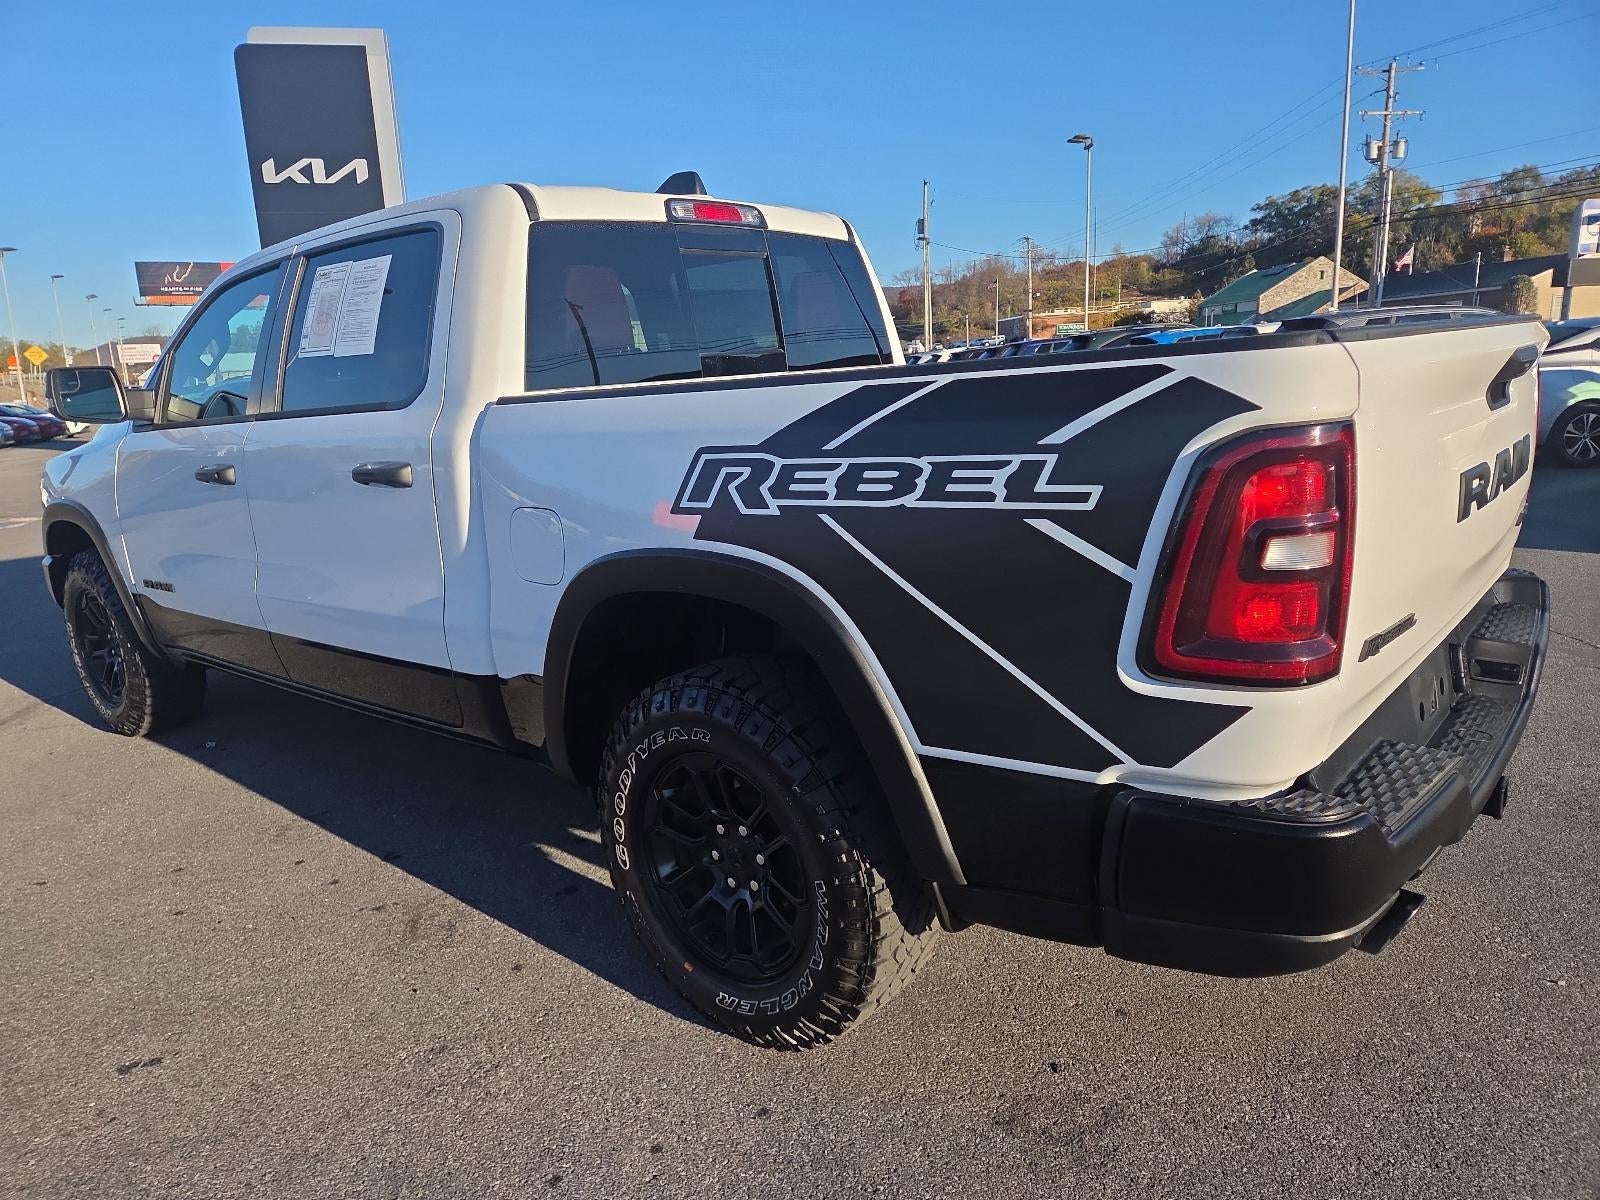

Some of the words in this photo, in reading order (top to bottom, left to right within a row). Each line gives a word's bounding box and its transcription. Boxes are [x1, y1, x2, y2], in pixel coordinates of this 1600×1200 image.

[261, 157, 369, 184] KIA
[679, 452, 1104, 515] REBEL
[1456, 433, 1530, 523] RAM
[613, 726, 711, 871] GOODYEAR
[715, 880, 829, 1016] WRANGLER
